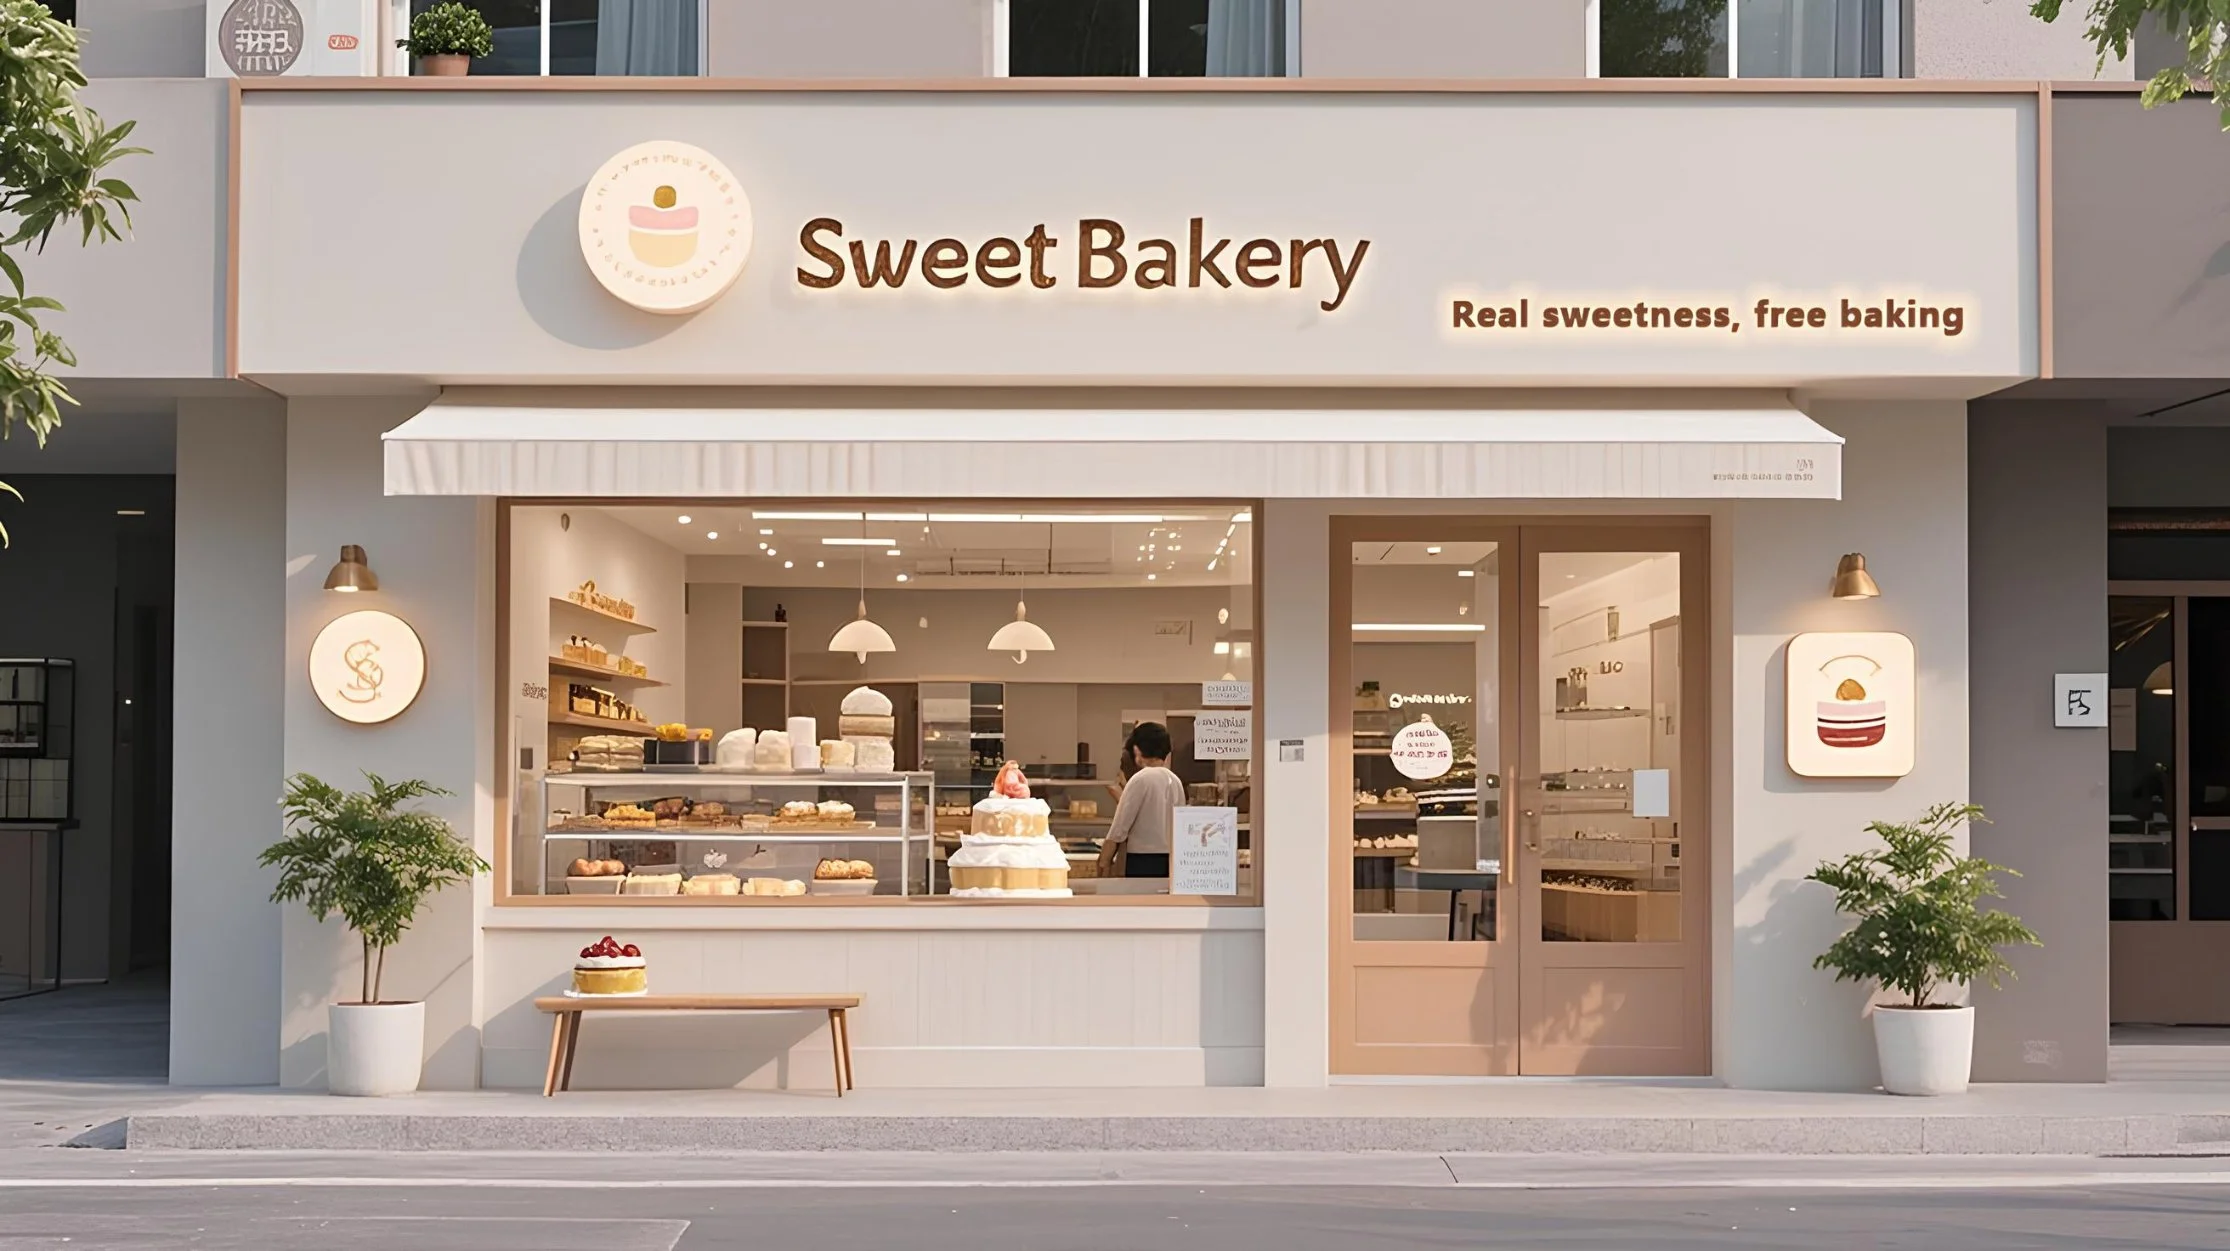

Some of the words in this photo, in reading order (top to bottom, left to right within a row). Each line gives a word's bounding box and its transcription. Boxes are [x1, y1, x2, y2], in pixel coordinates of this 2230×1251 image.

[796, 217, 1058, 290] Sweet
[1078, 216, 1371, 312] Bakery
[1453, 298, 1528, 328] Real
[1542, 302, 1740, 333] sweetness,
[1754, 298, 1827, 328] free
[1841, 298, 1964, 337] baking
